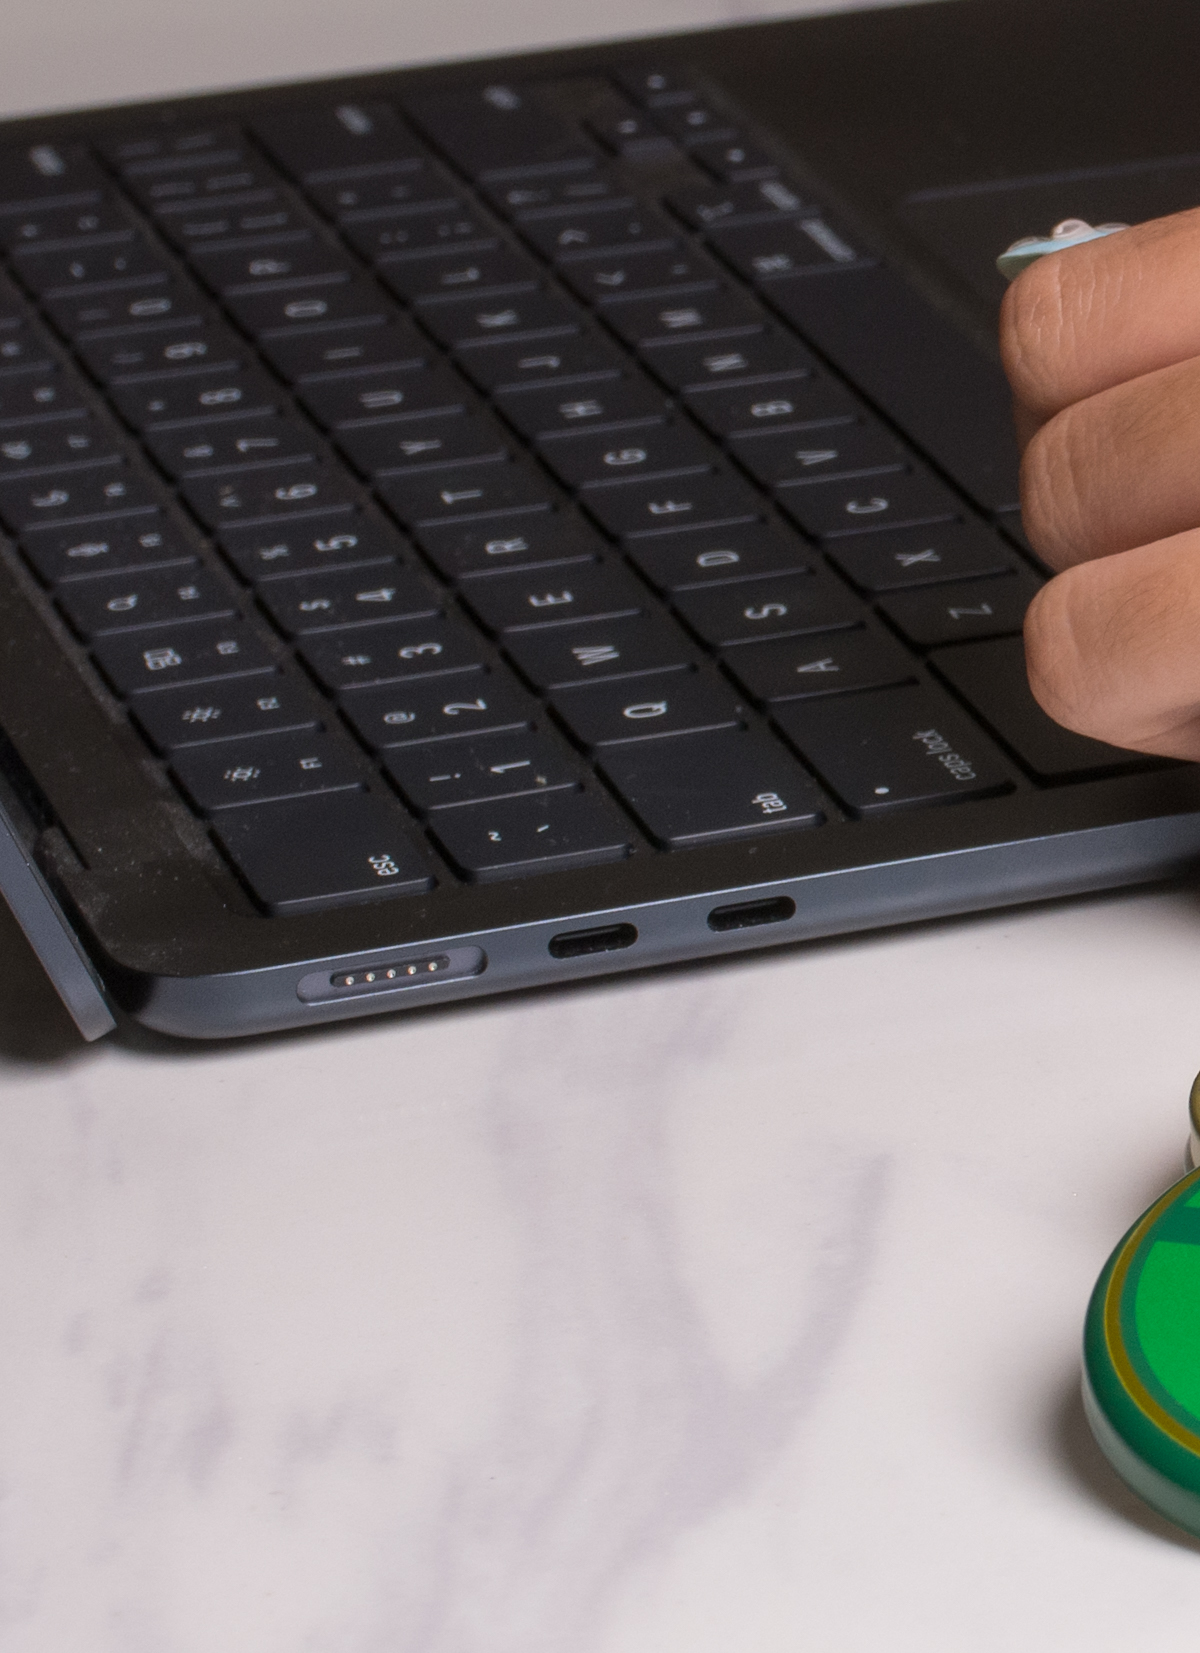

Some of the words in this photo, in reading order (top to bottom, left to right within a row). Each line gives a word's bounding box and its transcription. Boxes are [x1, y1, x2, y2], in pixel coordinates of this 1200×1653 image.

[752, 401, 792, 416] B
[604, 449, 646, 465] G
[797, 451, 837, 465] V
[276, 485, 316, 499] 6
[649, 501, 690, 514] F
[847, 498, 888, 513] C
[315, 535, 357, 551] 5
[486, 538, 526, 554] R
[697, 551, 739, 567] D
[896, 550, 939, 566] X
[357, 589, 393, 601] 4
[530, 591, 572, 606] E
[745, 604, 787, 619] S
[949, 604, 992, 619] Z
[399, 643, 441, 658] 3
[573, 646, 619, 665] W
[797, 659, 838, 672] A
[444, 699, 486, 715] 2
[624, 702, 666, 718] Q
[384, 712, 415, 724] @
[912, 729, 953, 755] lock
[491, 761, 530, 773] 1
[939, 753, 977, 781] caps
[430, 773, 461, 781] !
[753, 793, 786, 813] tab
[369, 855, 399, 875] esc
